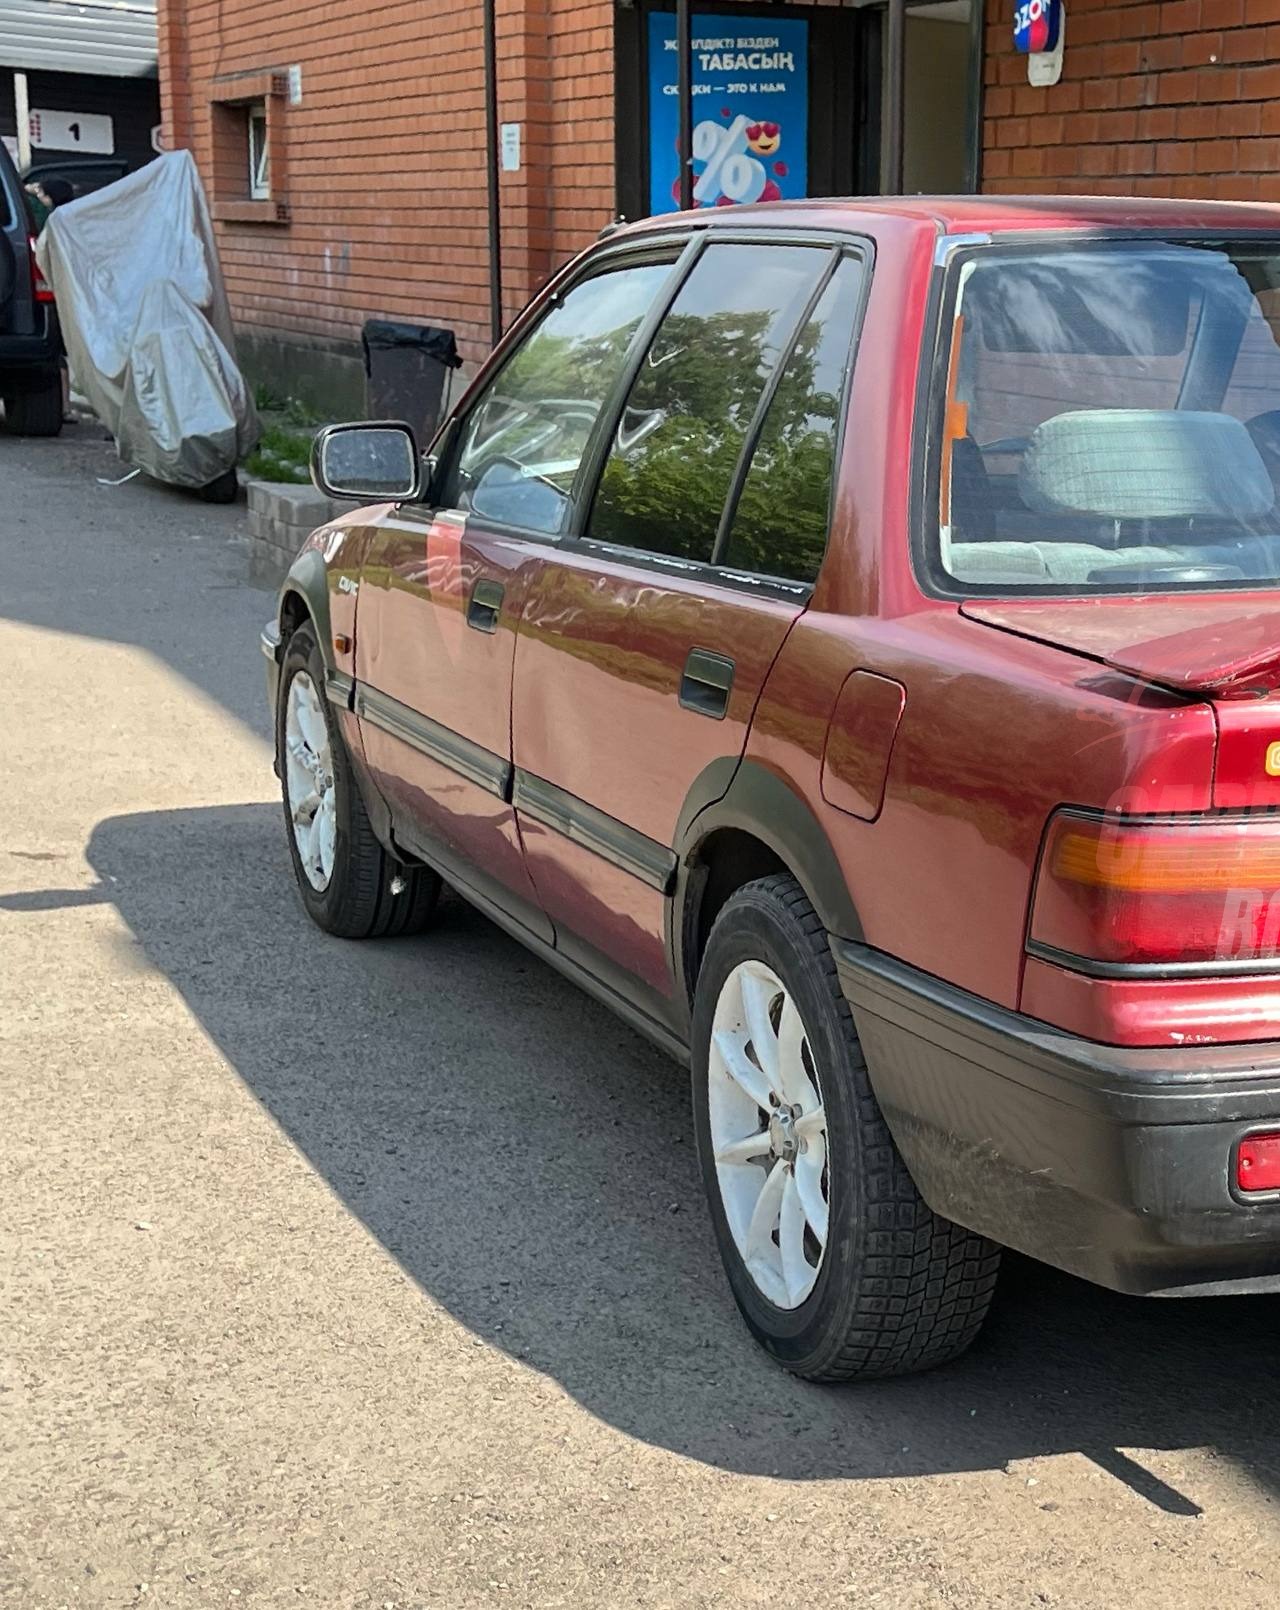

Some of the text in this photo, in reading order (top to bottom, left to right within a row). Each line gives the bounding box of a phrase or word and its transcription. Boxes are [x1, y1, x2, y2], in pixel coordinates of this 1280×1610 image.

[699, 52, 795, 72] ТАБАСЫҢ
[727, 83, 748, 93] ЭТО
[760, 83, 786, 93] НАМ
[69, 122, 80, 142] 1
